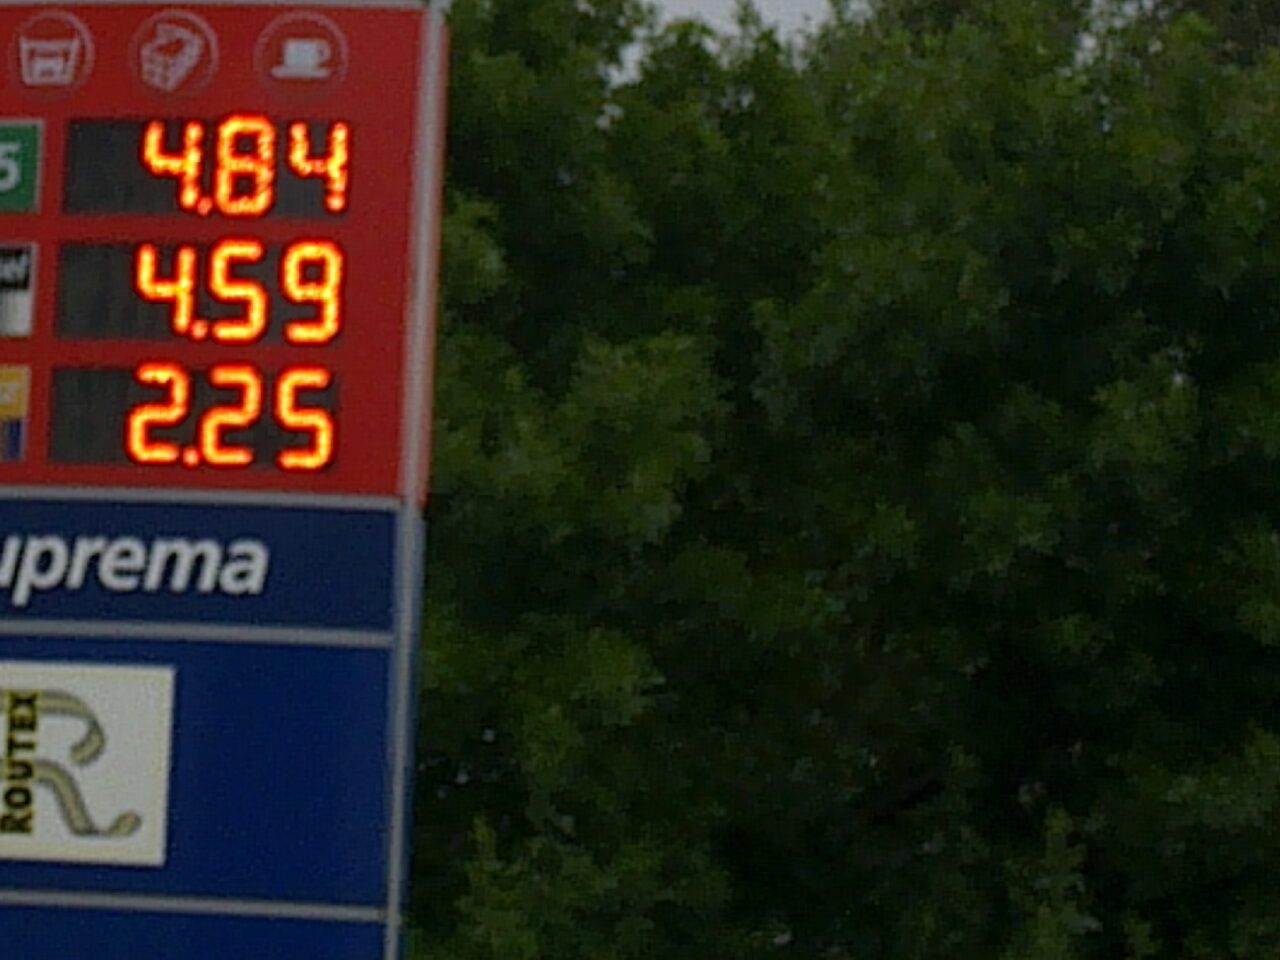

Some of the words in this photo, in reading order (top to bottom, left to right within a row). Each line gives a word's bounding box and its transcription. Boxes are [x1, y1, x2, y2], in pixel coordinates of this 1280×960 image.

[141, 116, 350, 216] 4.84
[135, 240, 344, 342] 4.59
[126, 363, 334, 470] 2.25
